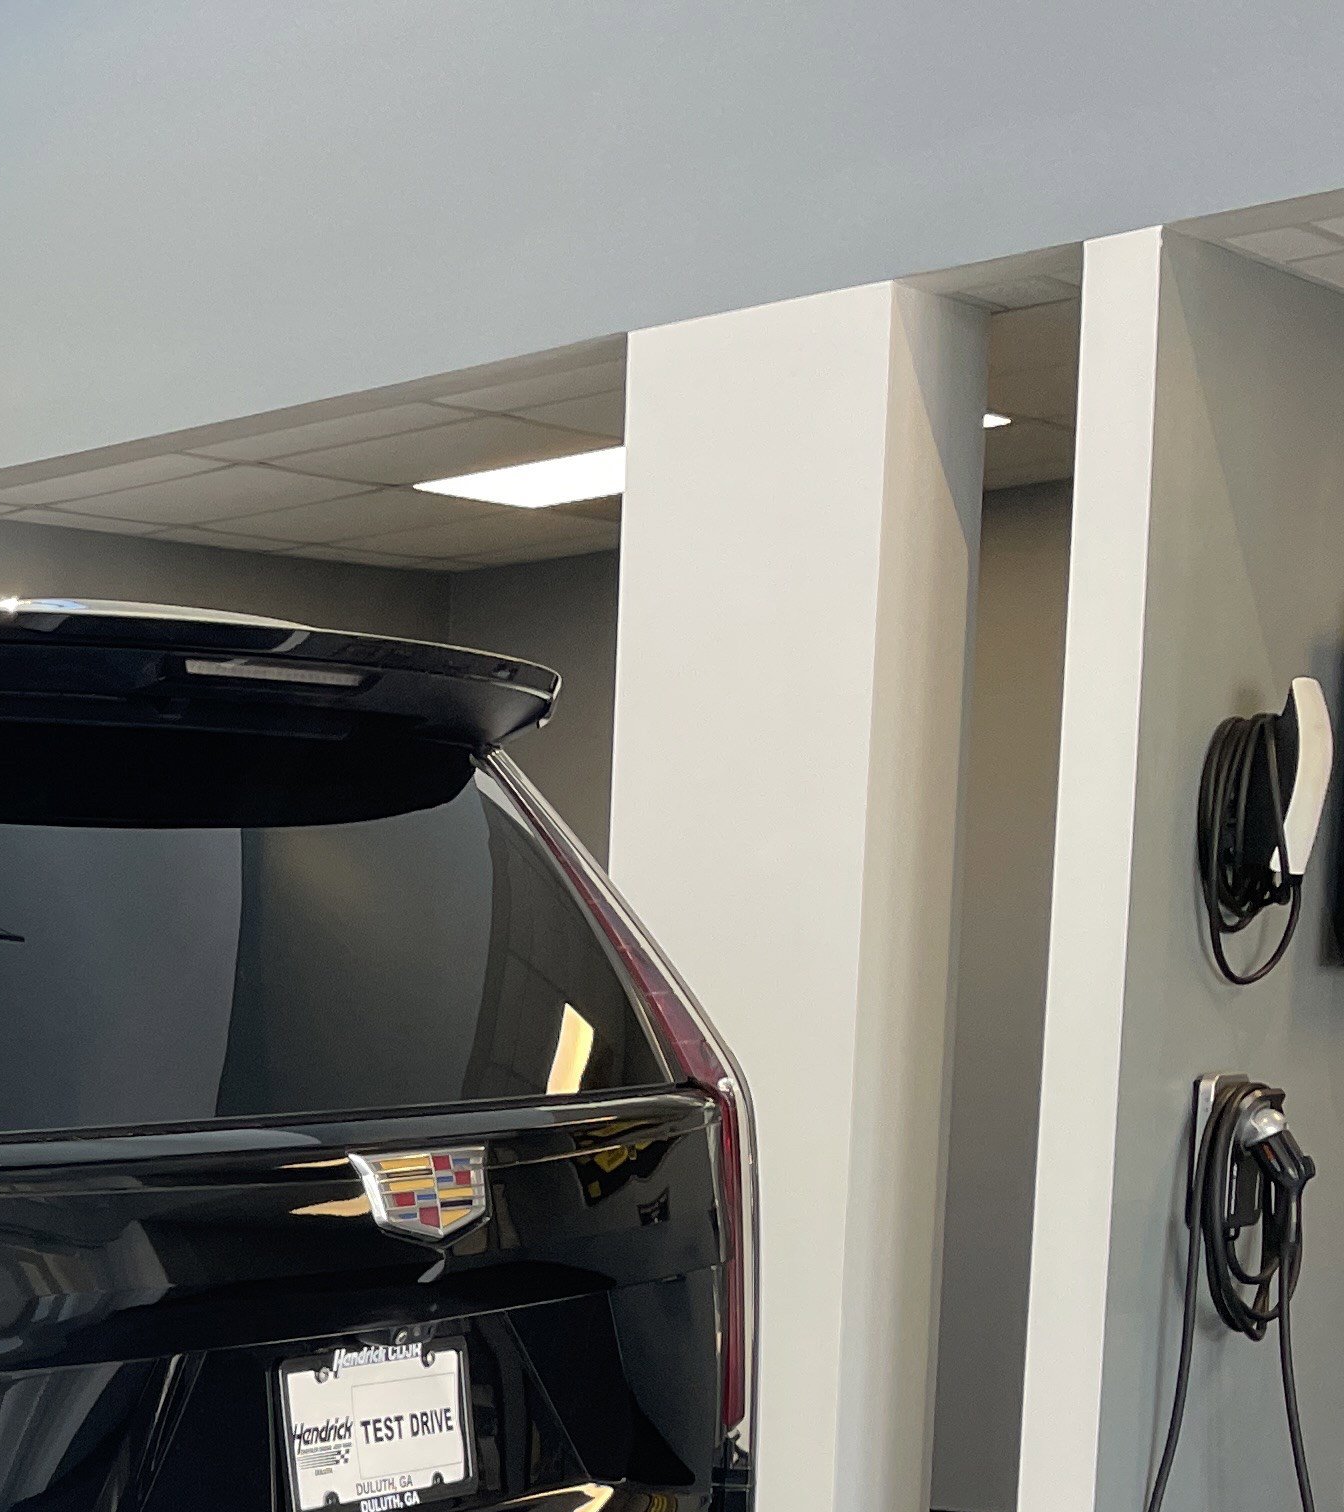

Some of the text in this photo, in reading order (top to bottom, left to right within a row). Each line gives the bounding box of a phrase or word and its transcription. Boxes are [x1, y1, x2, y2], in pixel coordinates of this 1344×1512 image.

[333, 1346, 387, 1373] Hendrick
[292, 1415, 353, 1455] Hendrick
[360, 1407, 454, 1445] TEST DRIVE
[355, 1474, 413, 1496] DULUTH, GA
[404, 1490, 421, 1506] GA
